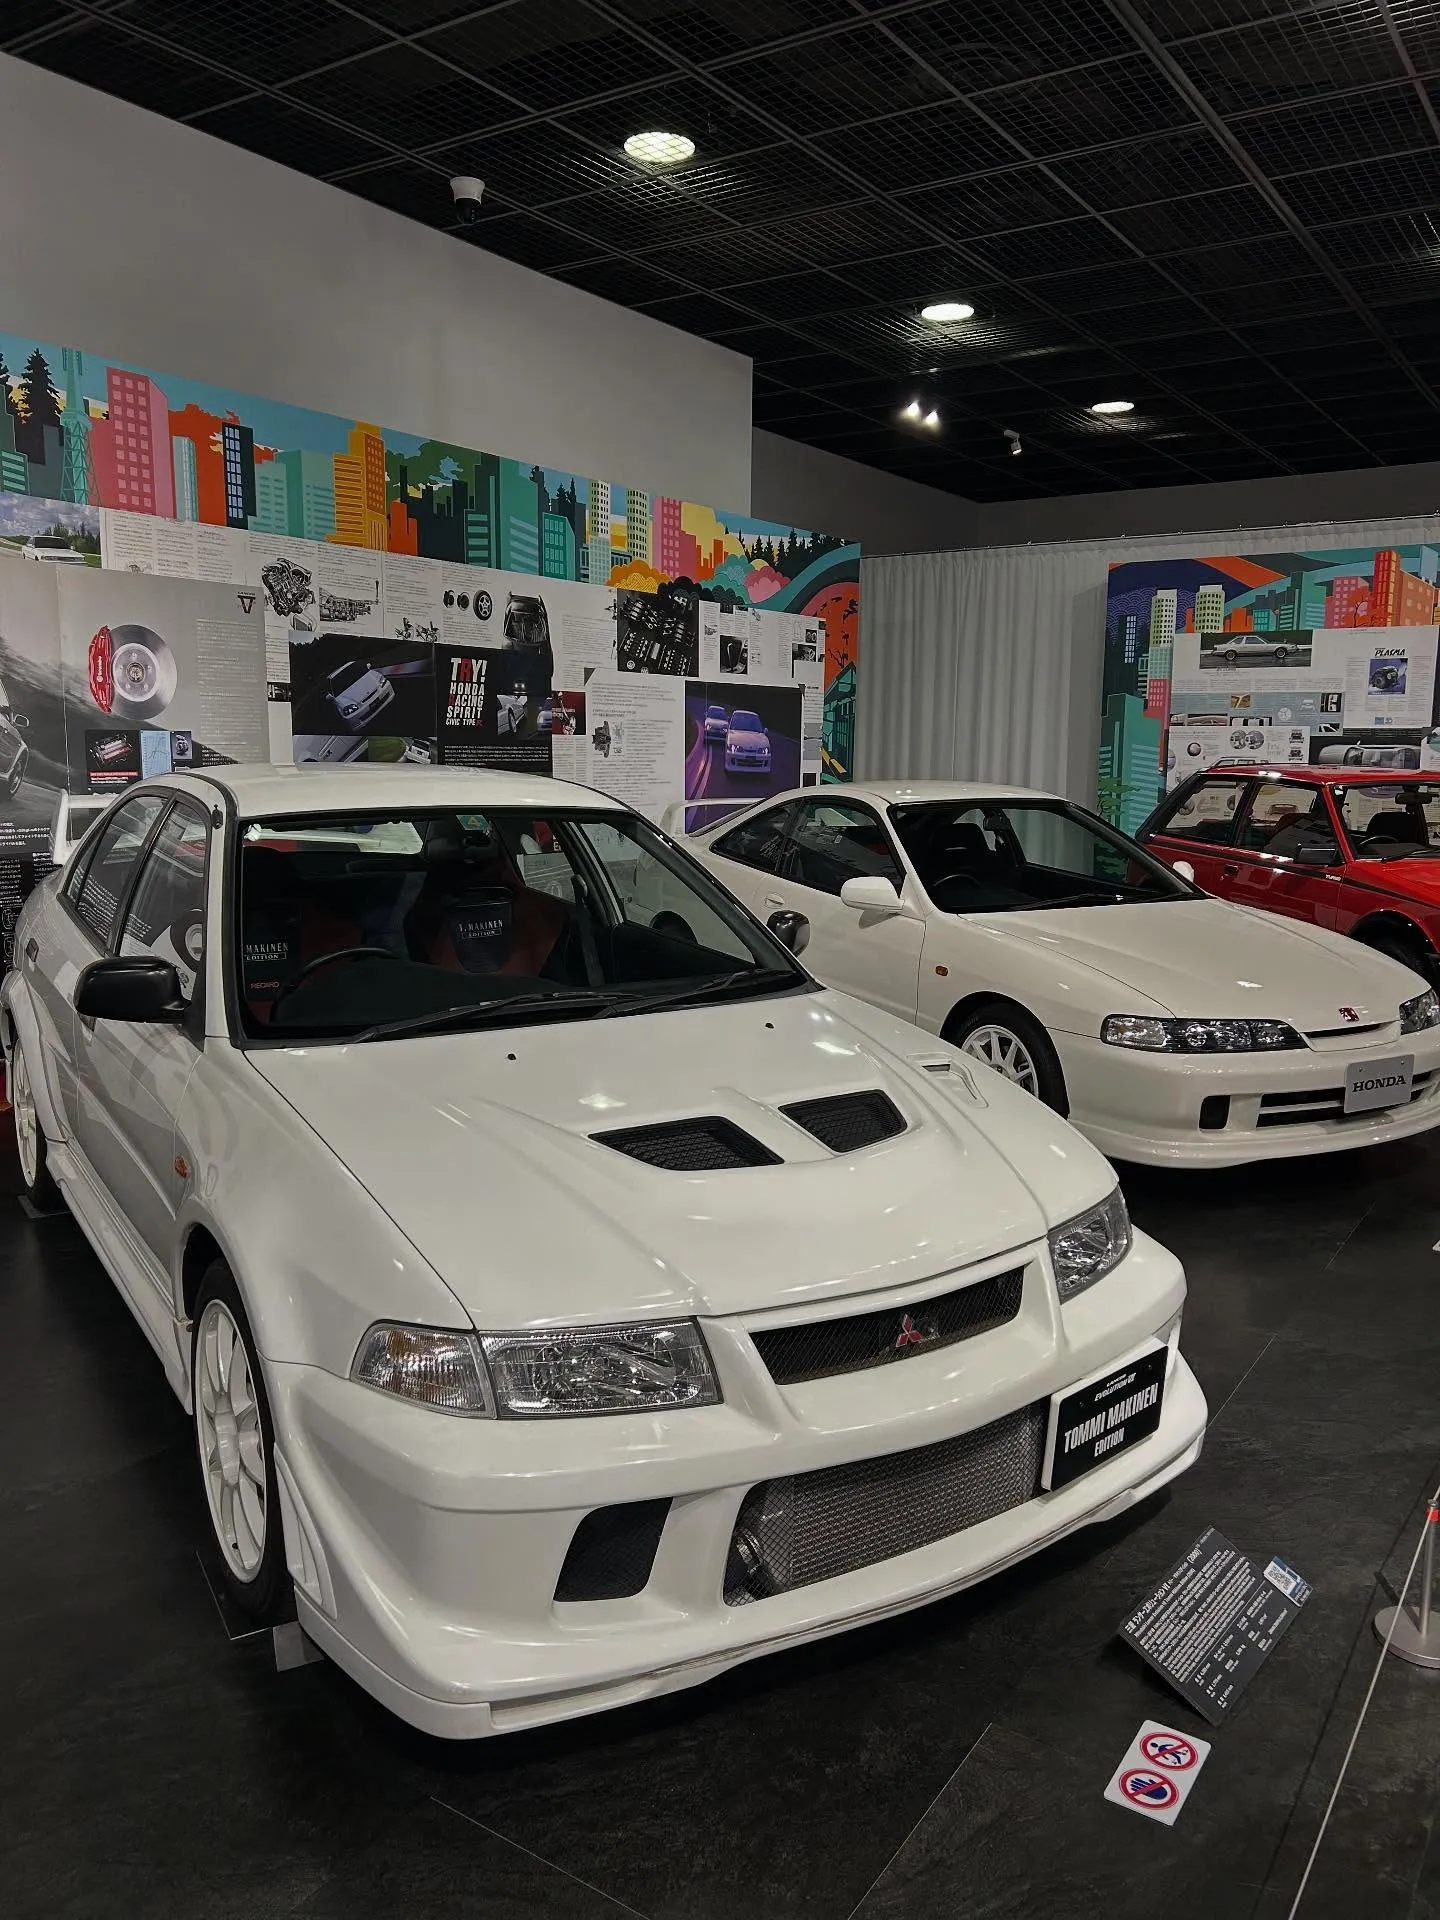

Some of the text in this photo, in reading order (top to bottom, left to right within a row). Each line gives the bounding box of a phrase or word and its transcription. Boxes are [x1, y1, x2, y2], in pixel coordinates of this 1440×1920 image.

[450, 657, 488, 683] TRY!
[449, 682, 485, 695] HONDA
[448, 694, 484, 707] RACING
[446, 705, 482, 719] SPIRIT
[445, 718, 461, 726] CIVIC
[246, 942, 289, 954] MAKINEN
[246, 953, 280, 961] EDITION
[1352, 1075, 1406, 1092] HONDA
[1064, 1382, 1159, 1454] TOMMI MAKINEN
[1093, 1427, 1125, 1457] EDITION
